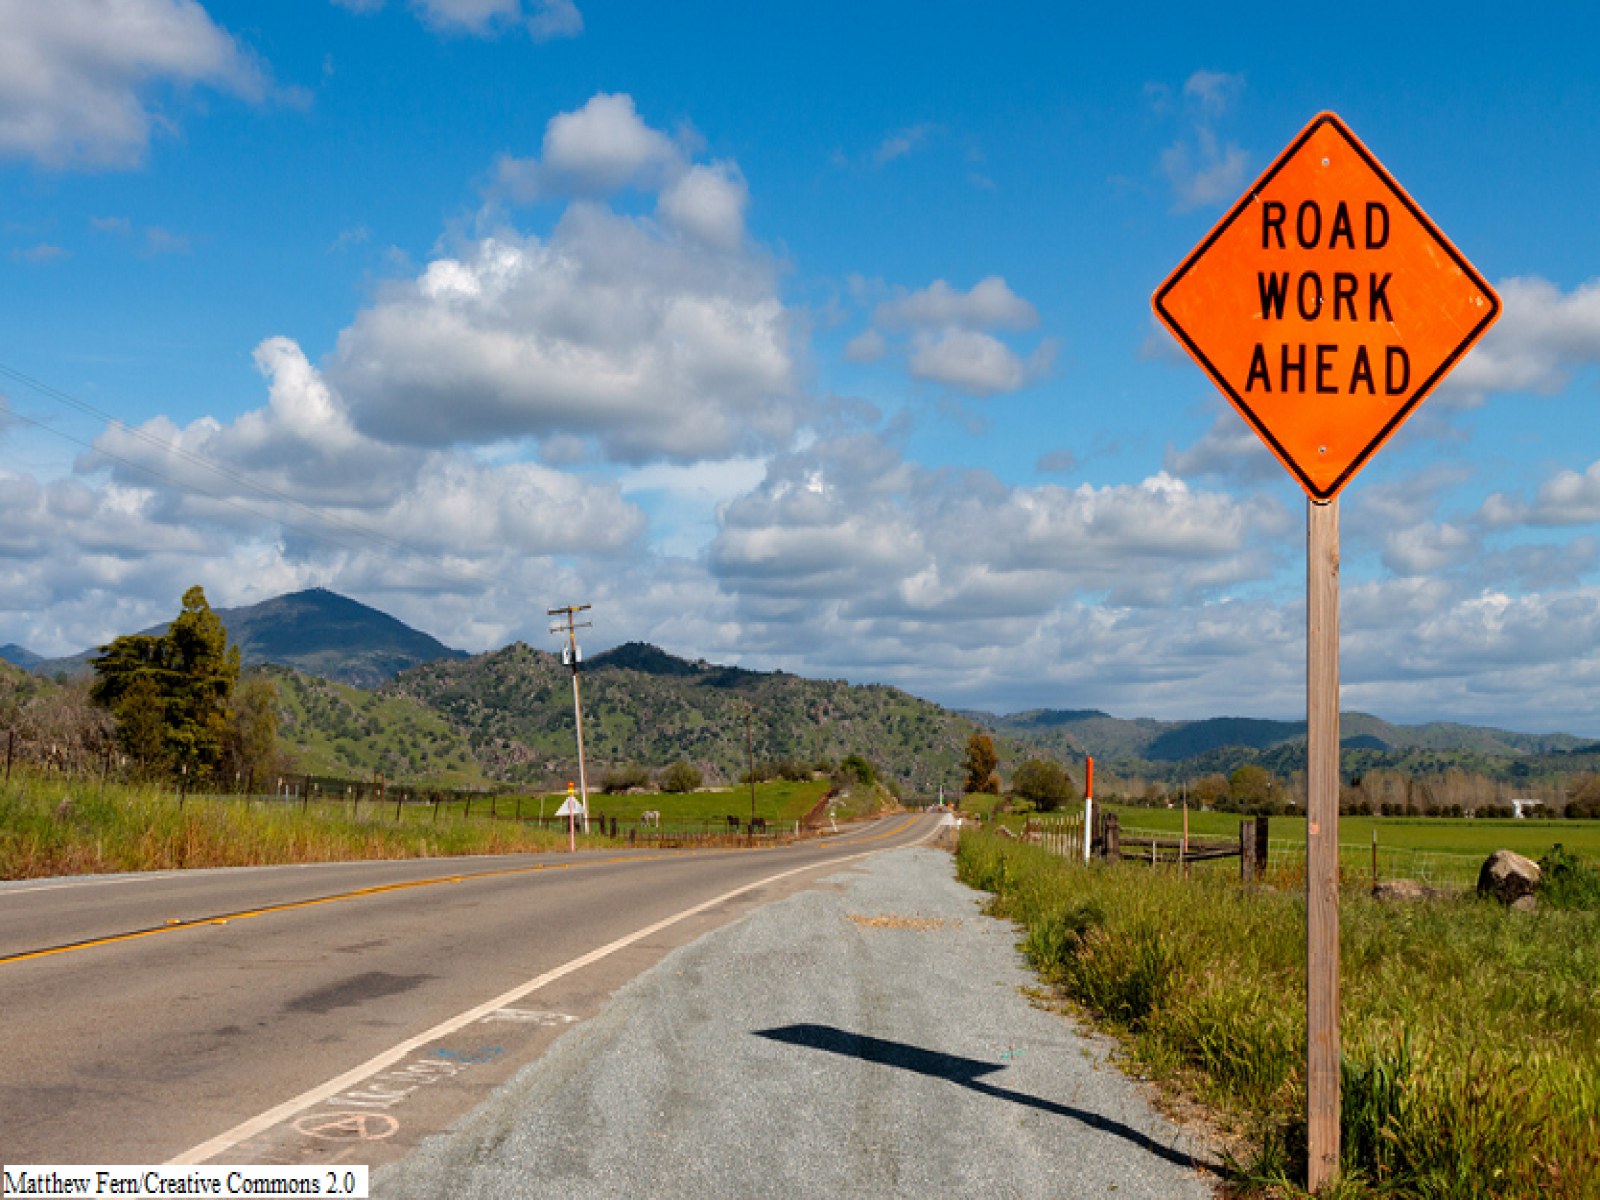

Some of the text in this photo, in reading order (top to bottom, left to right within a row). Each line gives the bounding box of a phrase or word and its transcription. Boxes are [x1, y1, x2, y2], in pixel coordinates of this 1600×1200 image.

[1262, 199, 1390, 250] ROAD
[1257, 271, 1394, 322] WORK
[1245, 344, 1411, 395] AHEAD
